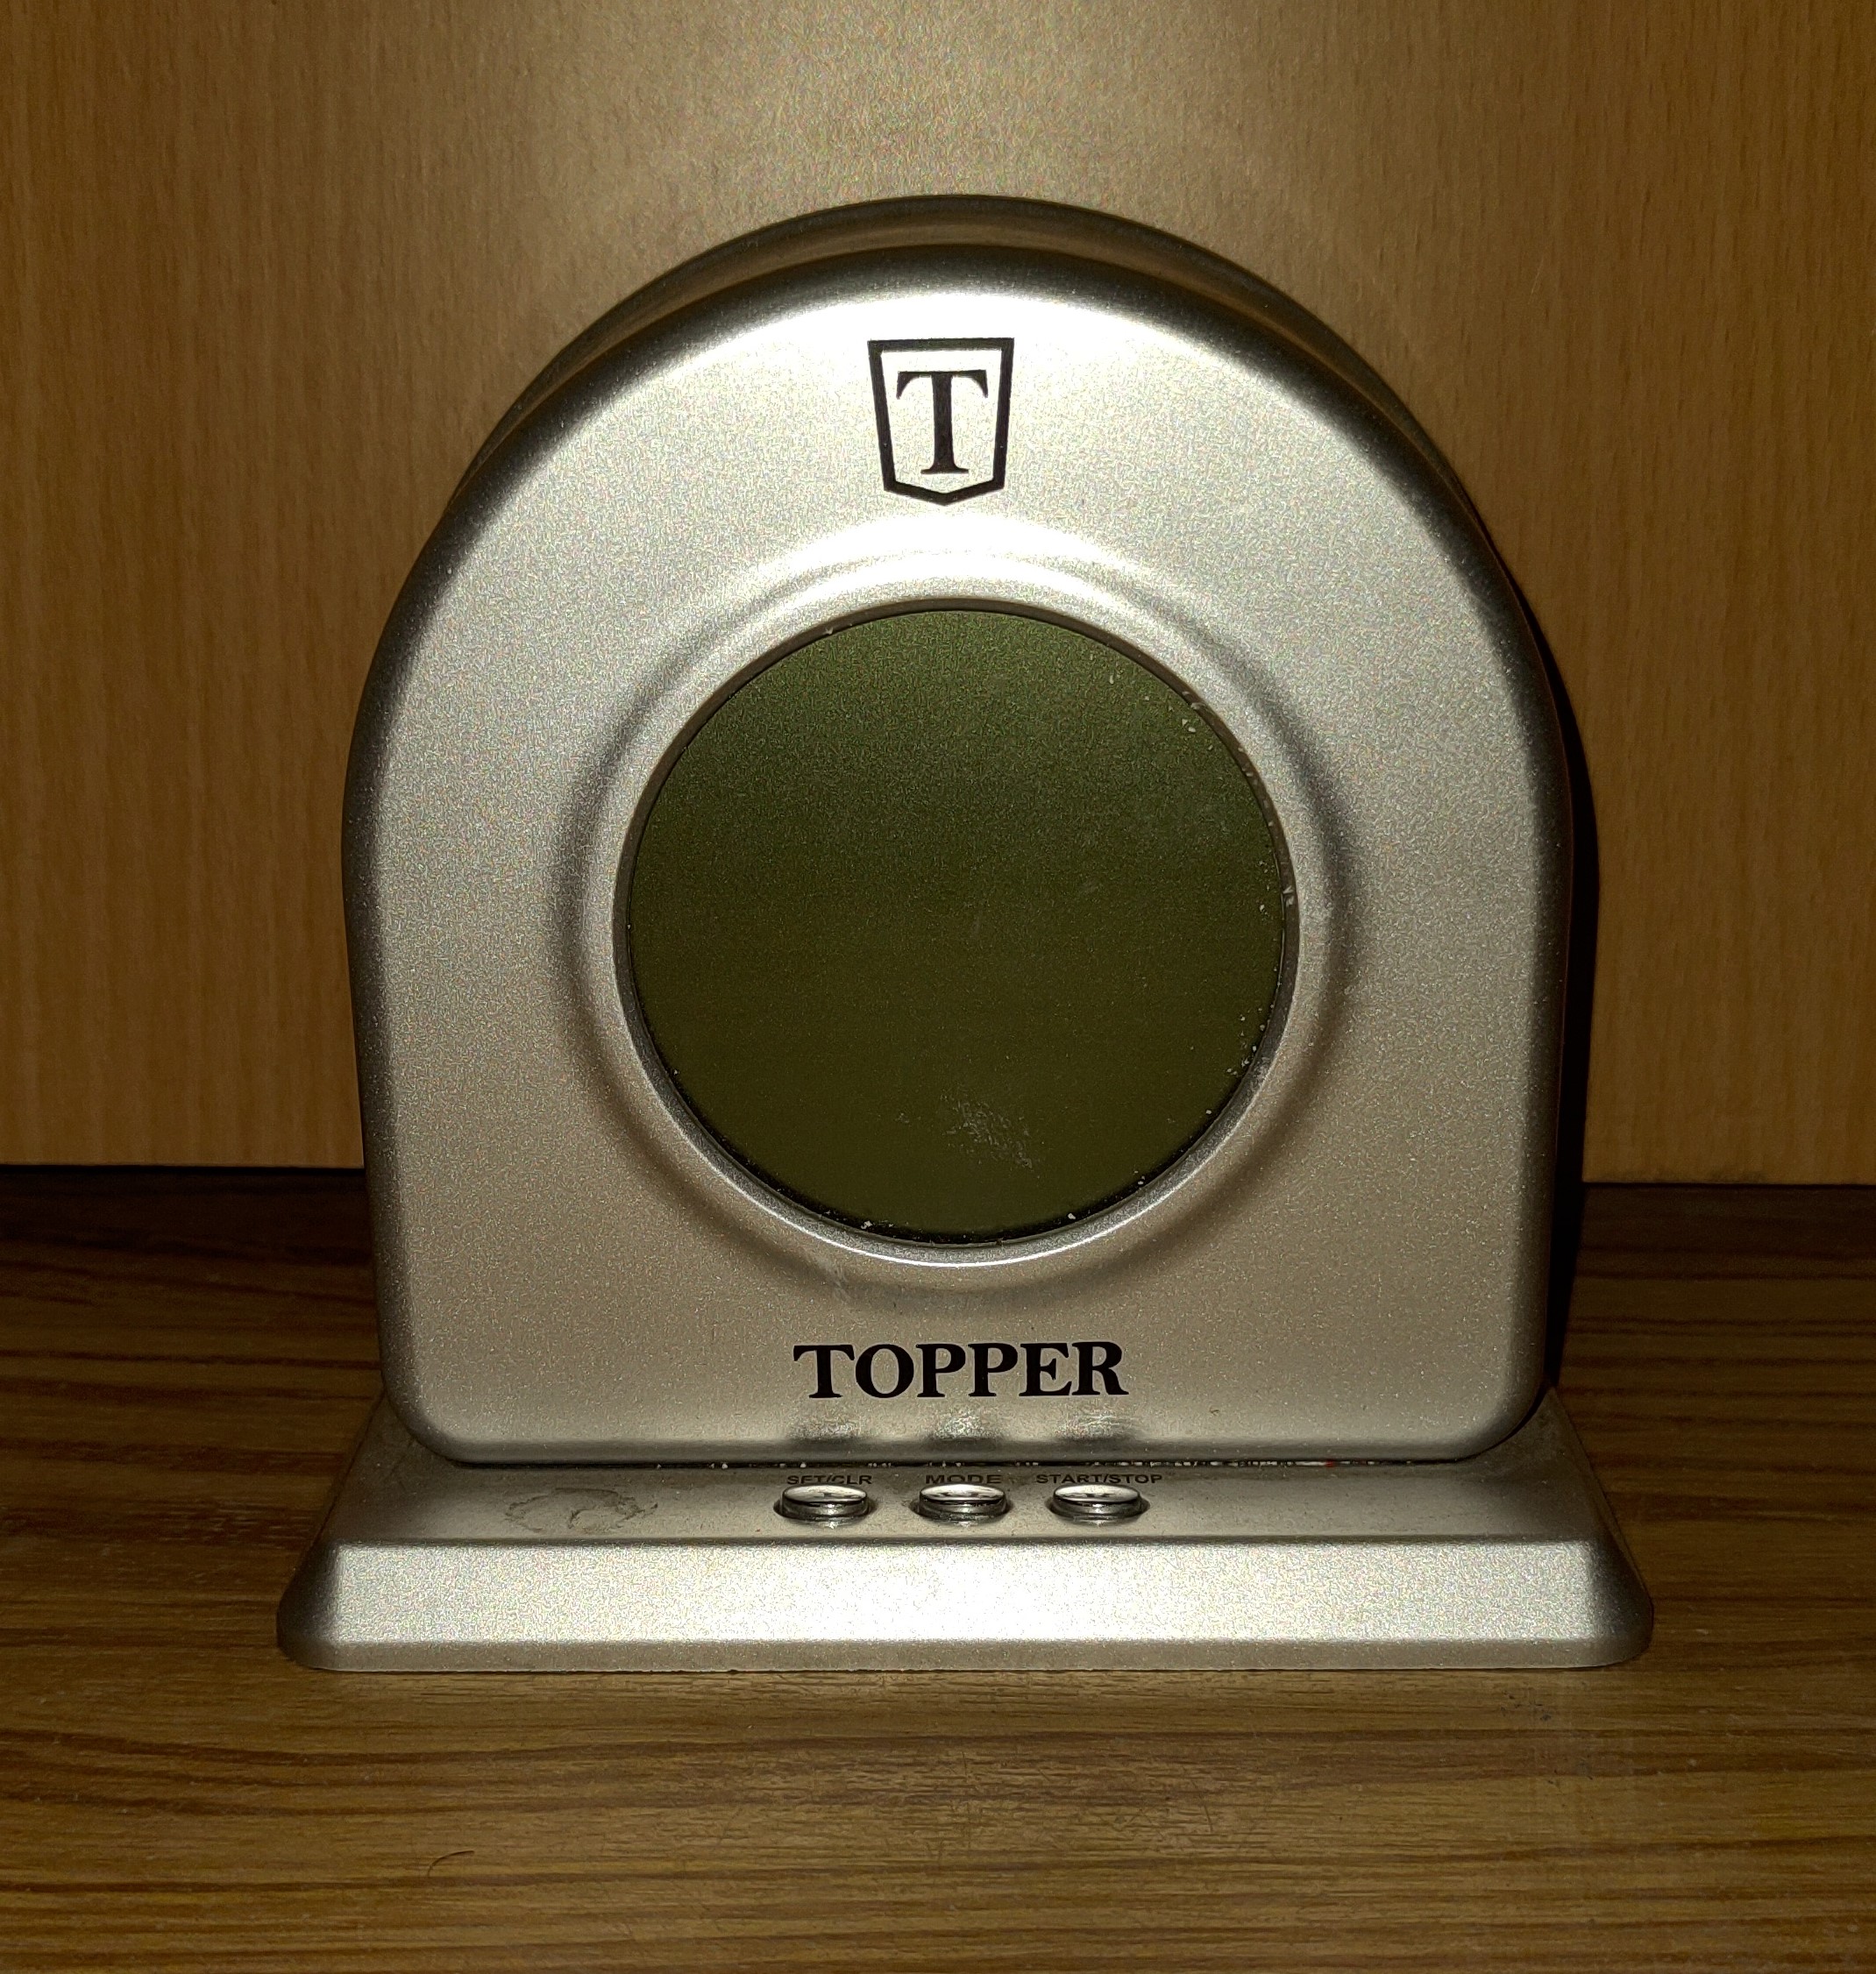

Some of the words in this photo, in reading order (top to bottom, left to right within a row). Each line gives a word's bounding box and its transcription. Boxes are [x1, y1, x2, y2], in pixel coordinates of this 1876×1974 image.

[896, 370, 988, 474] T
[793, 1341, 1129, 1398] TOPPER
[925, 1474, 1002, 1484] MODE
[1036, 1473, 1162, 1484] START/STOP
